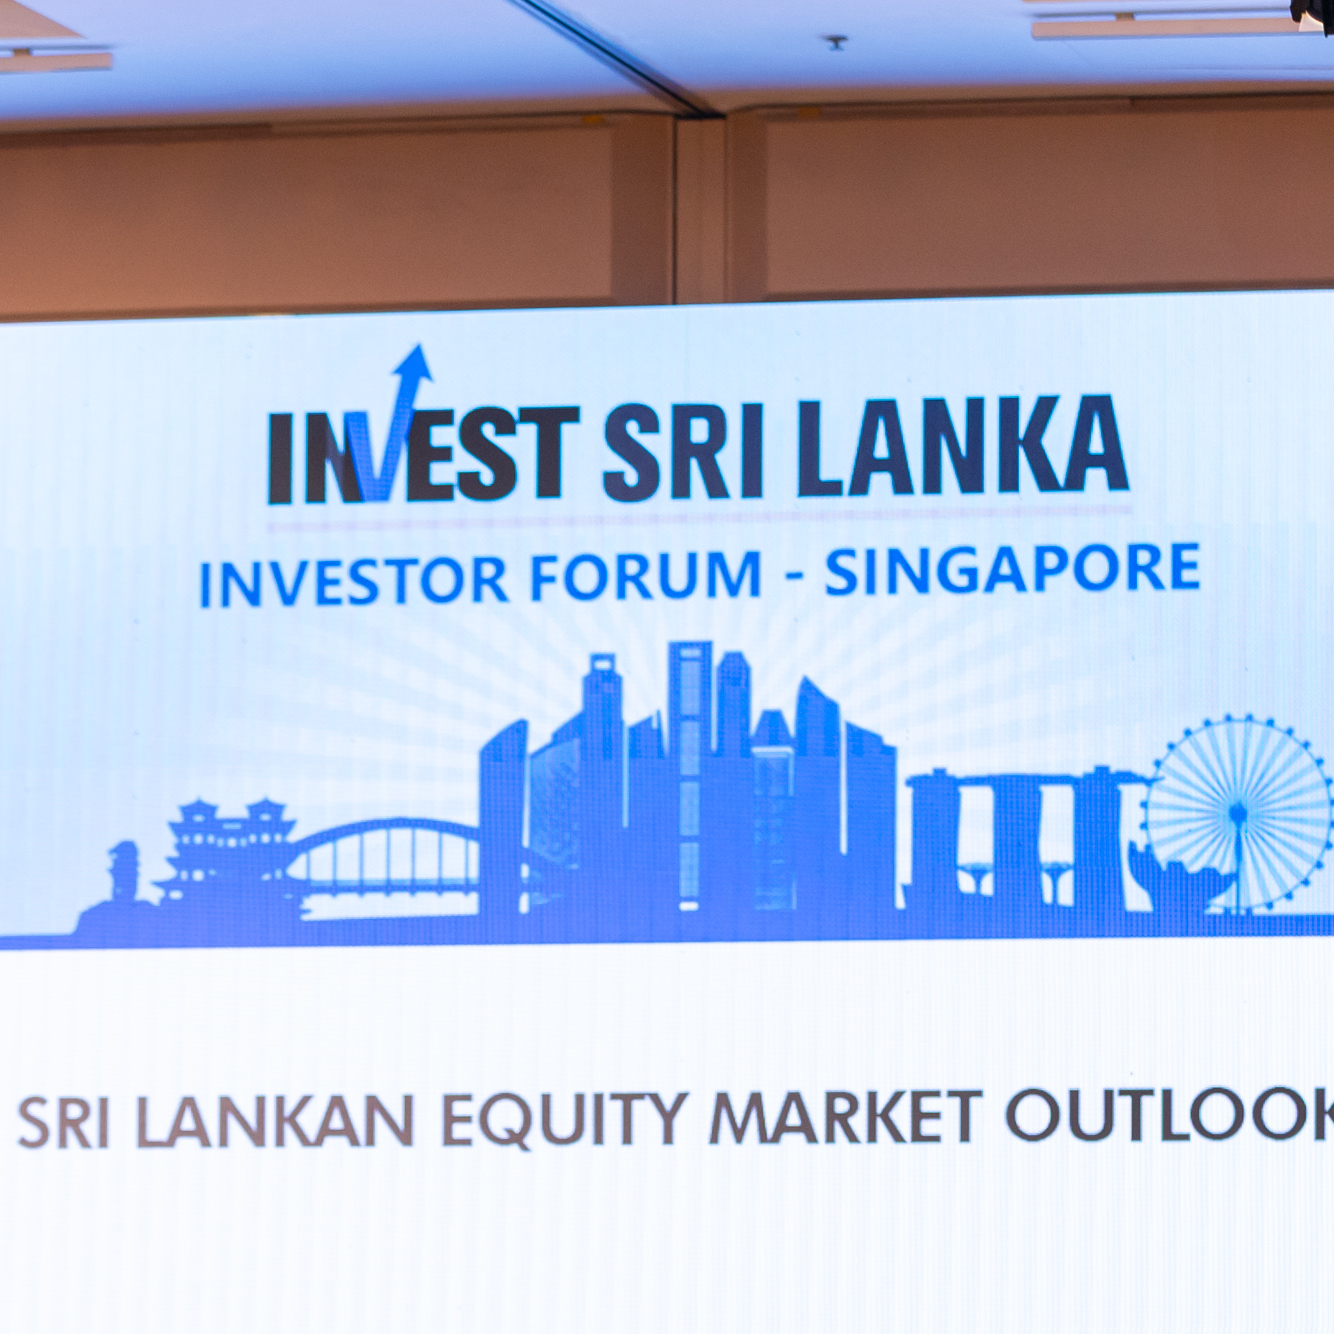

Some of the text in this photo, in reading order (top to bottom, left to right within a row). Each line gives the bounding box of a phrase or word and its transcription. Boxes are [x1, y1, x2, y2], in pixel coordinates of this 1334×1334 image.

[267, 376, 1130, 505] INVEST SRI LANKA
[199, 555, 506, 609] INVESTOR
[532, 549, 762, 602] FORUM
[825, 541, 1201, 598] SINGAPORE
[18, 1095, 110, 1150] SRI
[137, 1093, 417, 1149] LANKAN
[440, 1090, 690, 1154] EQUITY
[709, 1089, 984, 1146] MARKET
